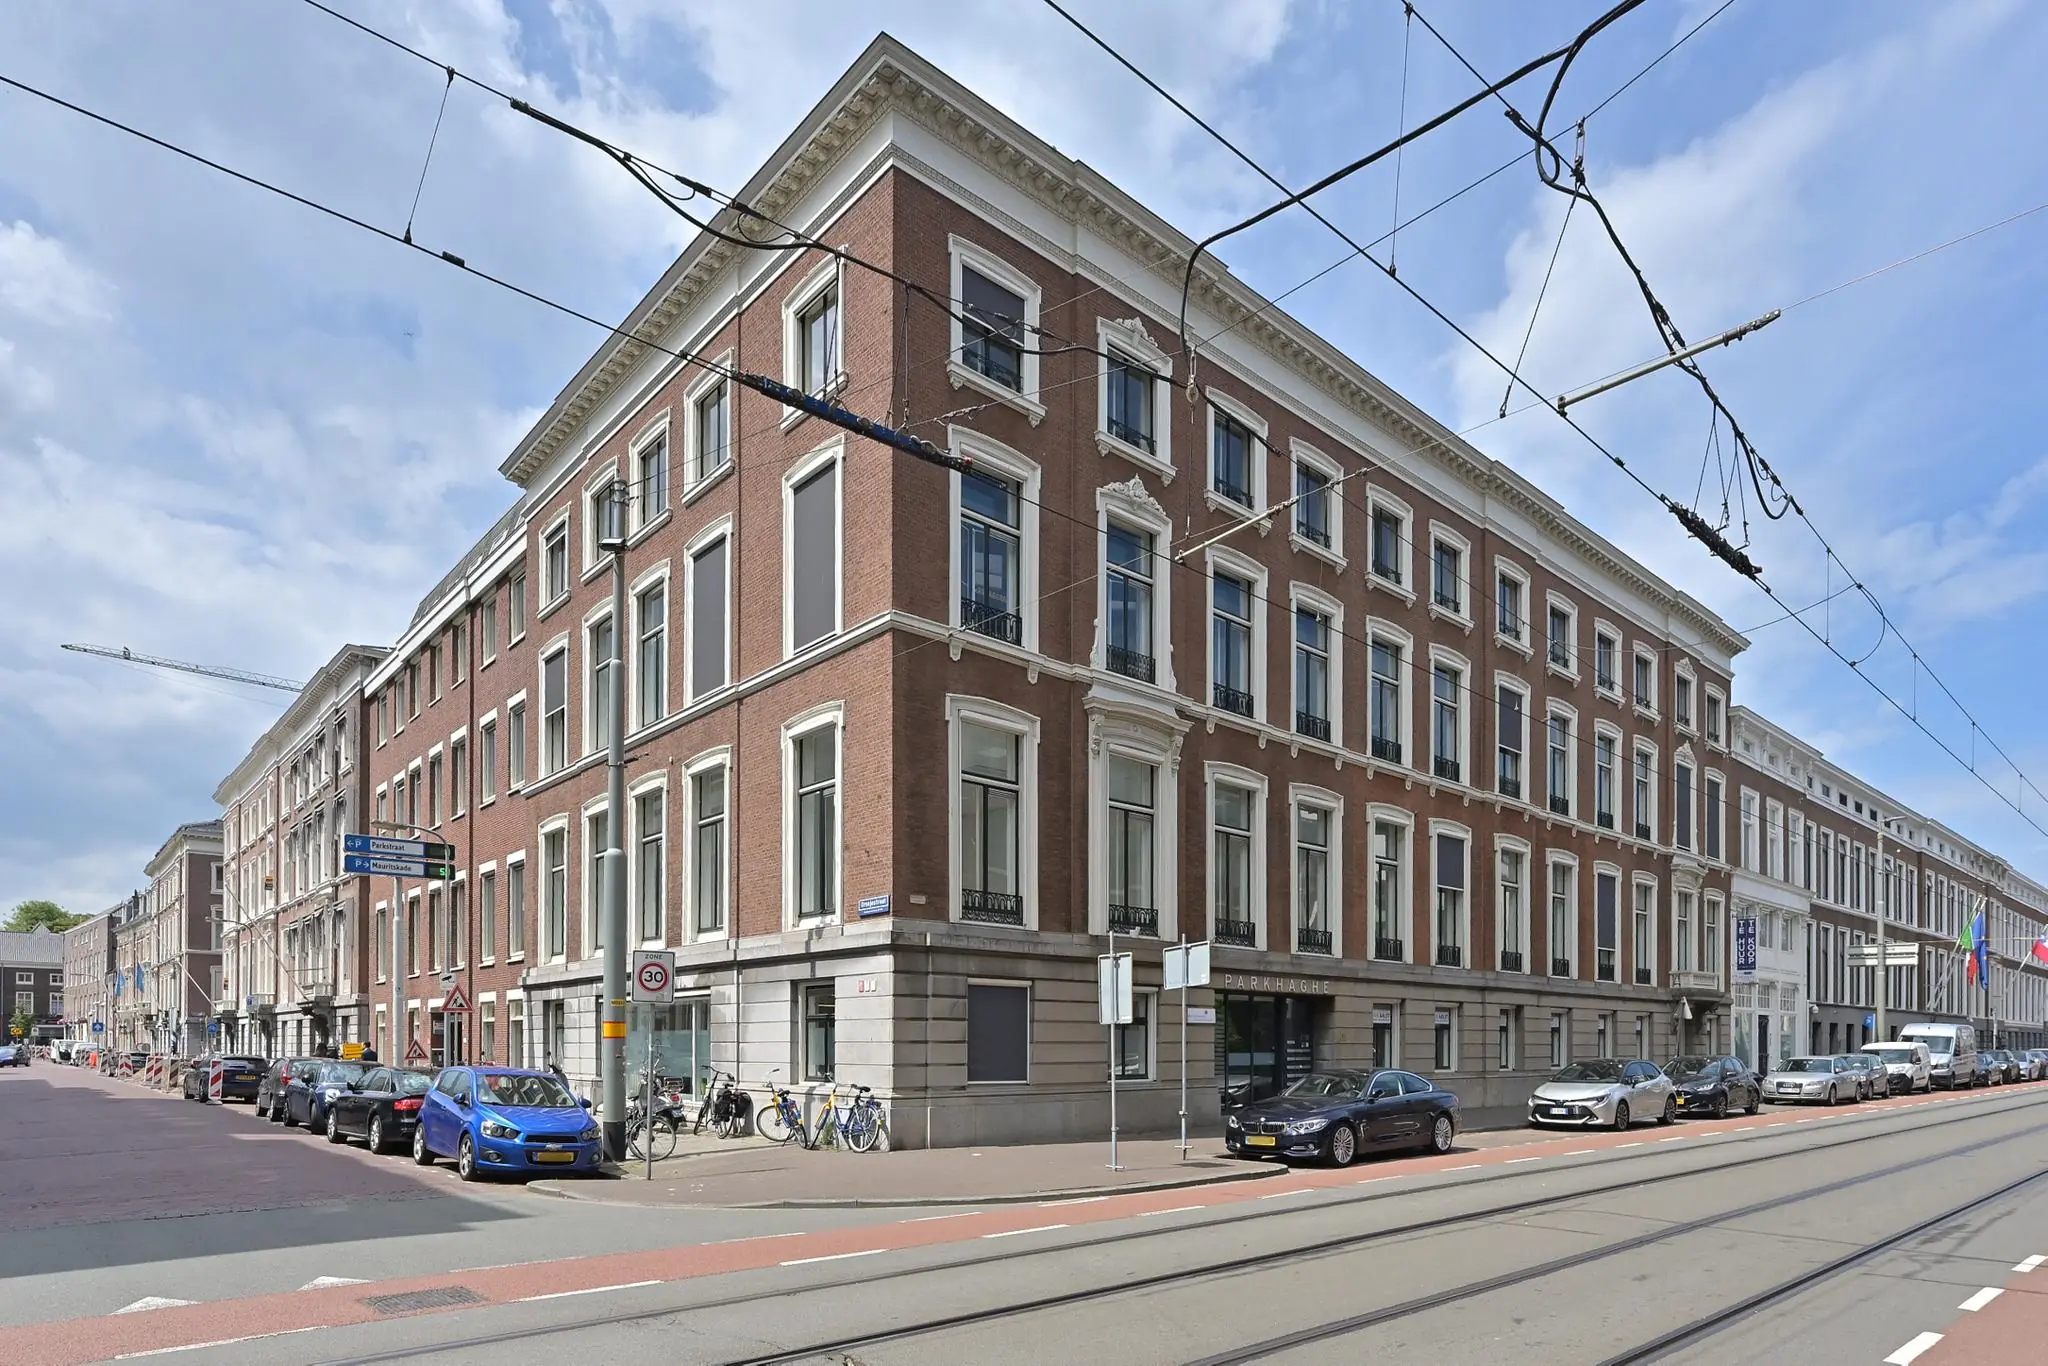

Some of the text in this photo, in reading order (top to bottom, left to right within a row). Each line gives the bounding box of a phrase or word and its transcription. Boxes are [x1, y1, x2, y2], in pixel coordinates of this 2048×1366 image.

[371, 841, 405, 852] Parkstraat
[371, 862, 412, 872] Mauritskade
[1738, 920, 1745, 934] TE
[1747, 920, 1755, 965] TE KOOP
[644, 971, 664, 983] 30
[1225, 974, 1329, 994] PARKHAGHE
